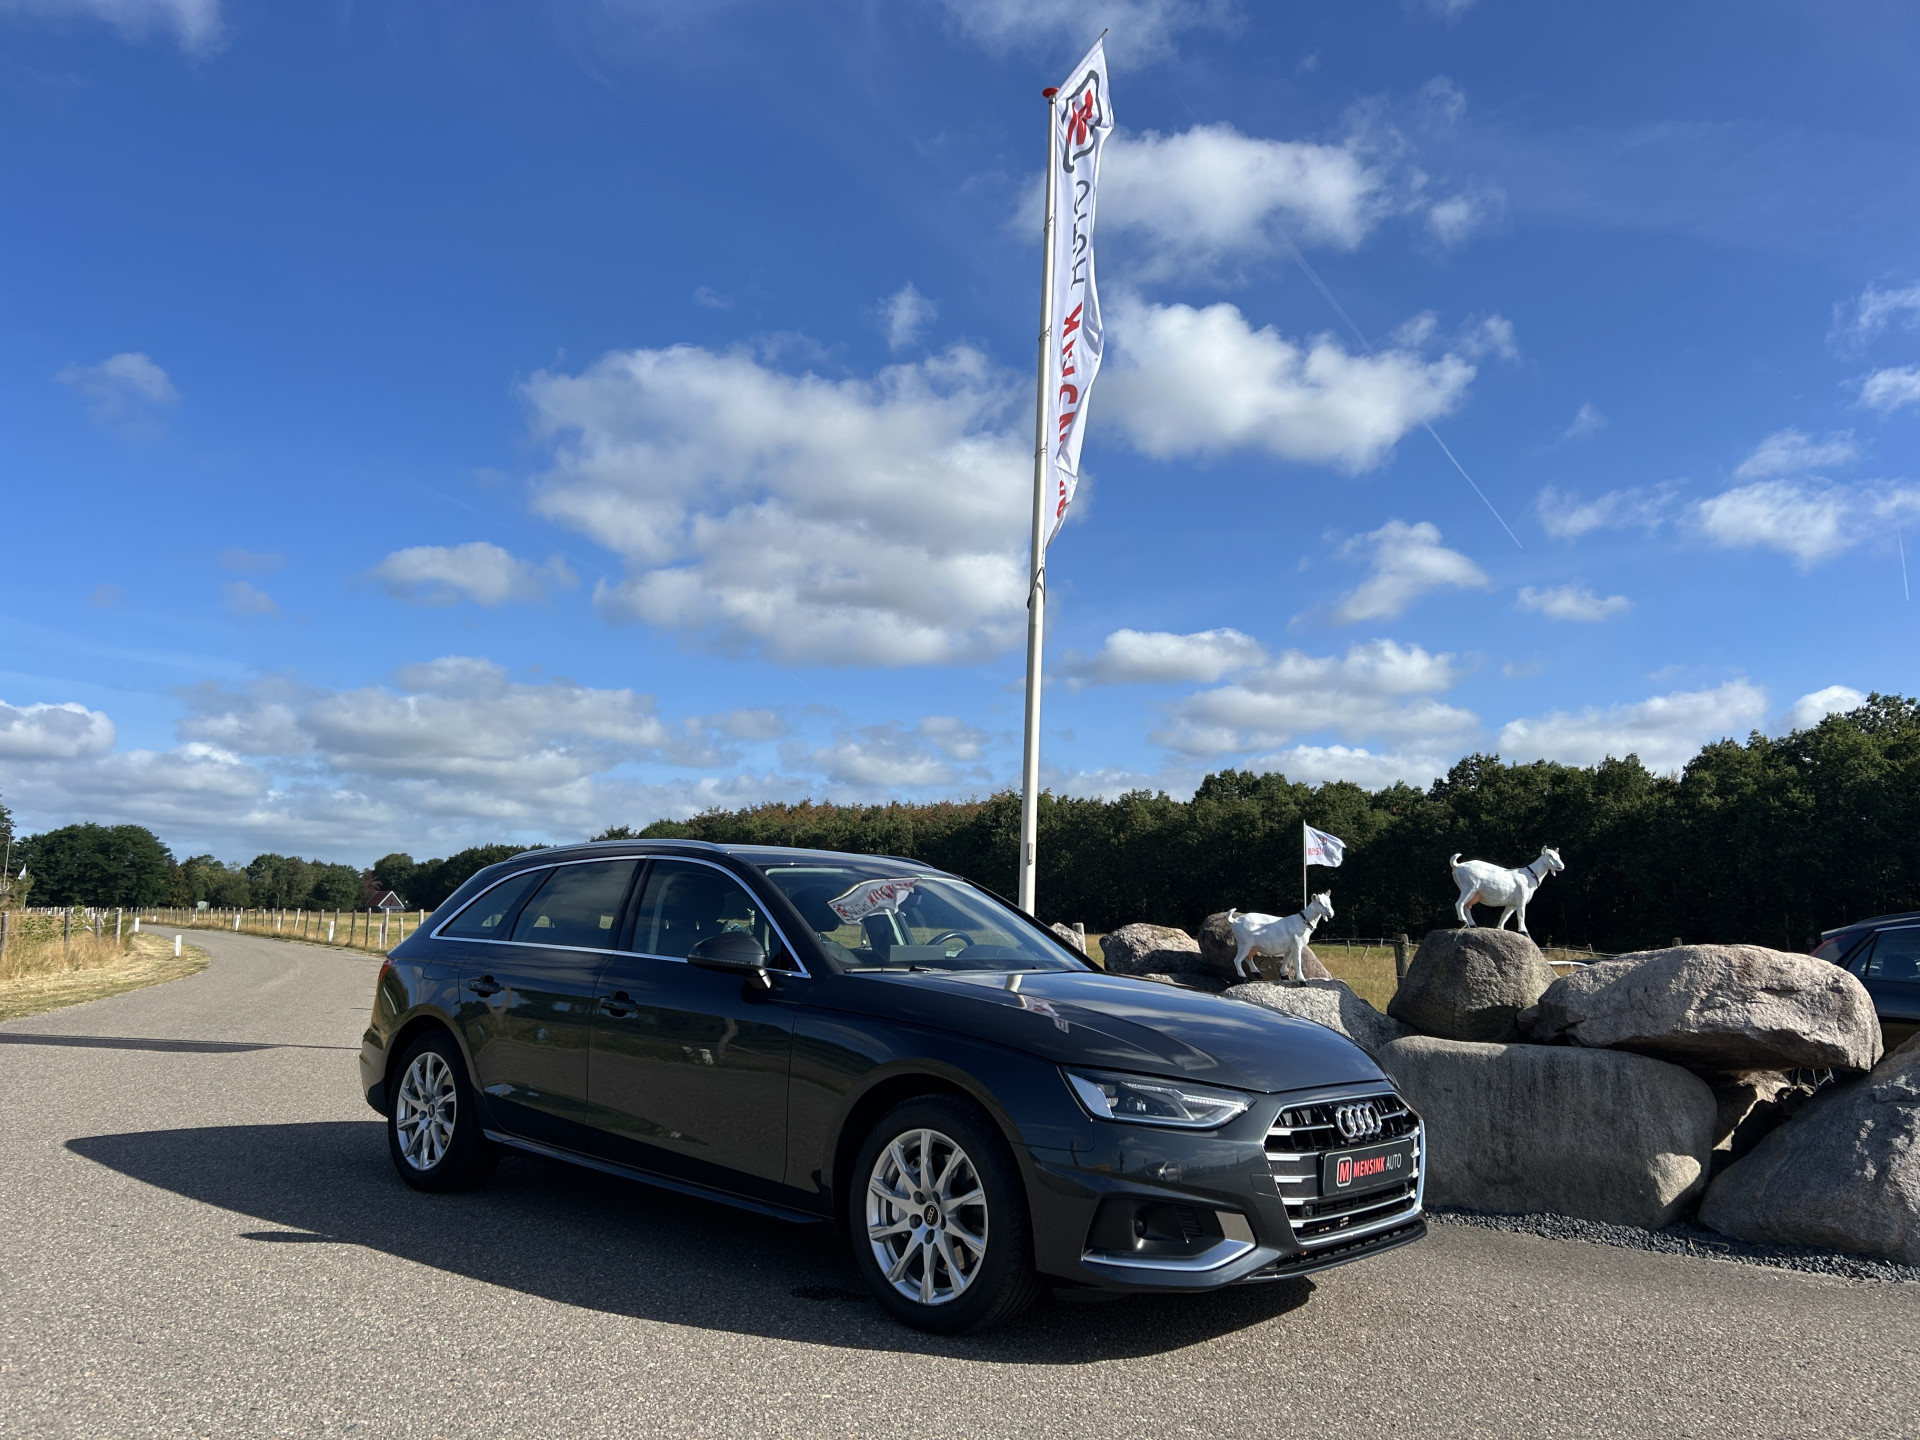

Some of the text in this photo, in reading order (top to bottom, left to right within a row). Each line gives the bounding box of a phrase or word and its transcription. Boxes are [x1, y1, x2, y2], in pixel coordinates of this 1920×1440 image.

[1339, 1153, 1402, 1182] M MENSINK AUTO
